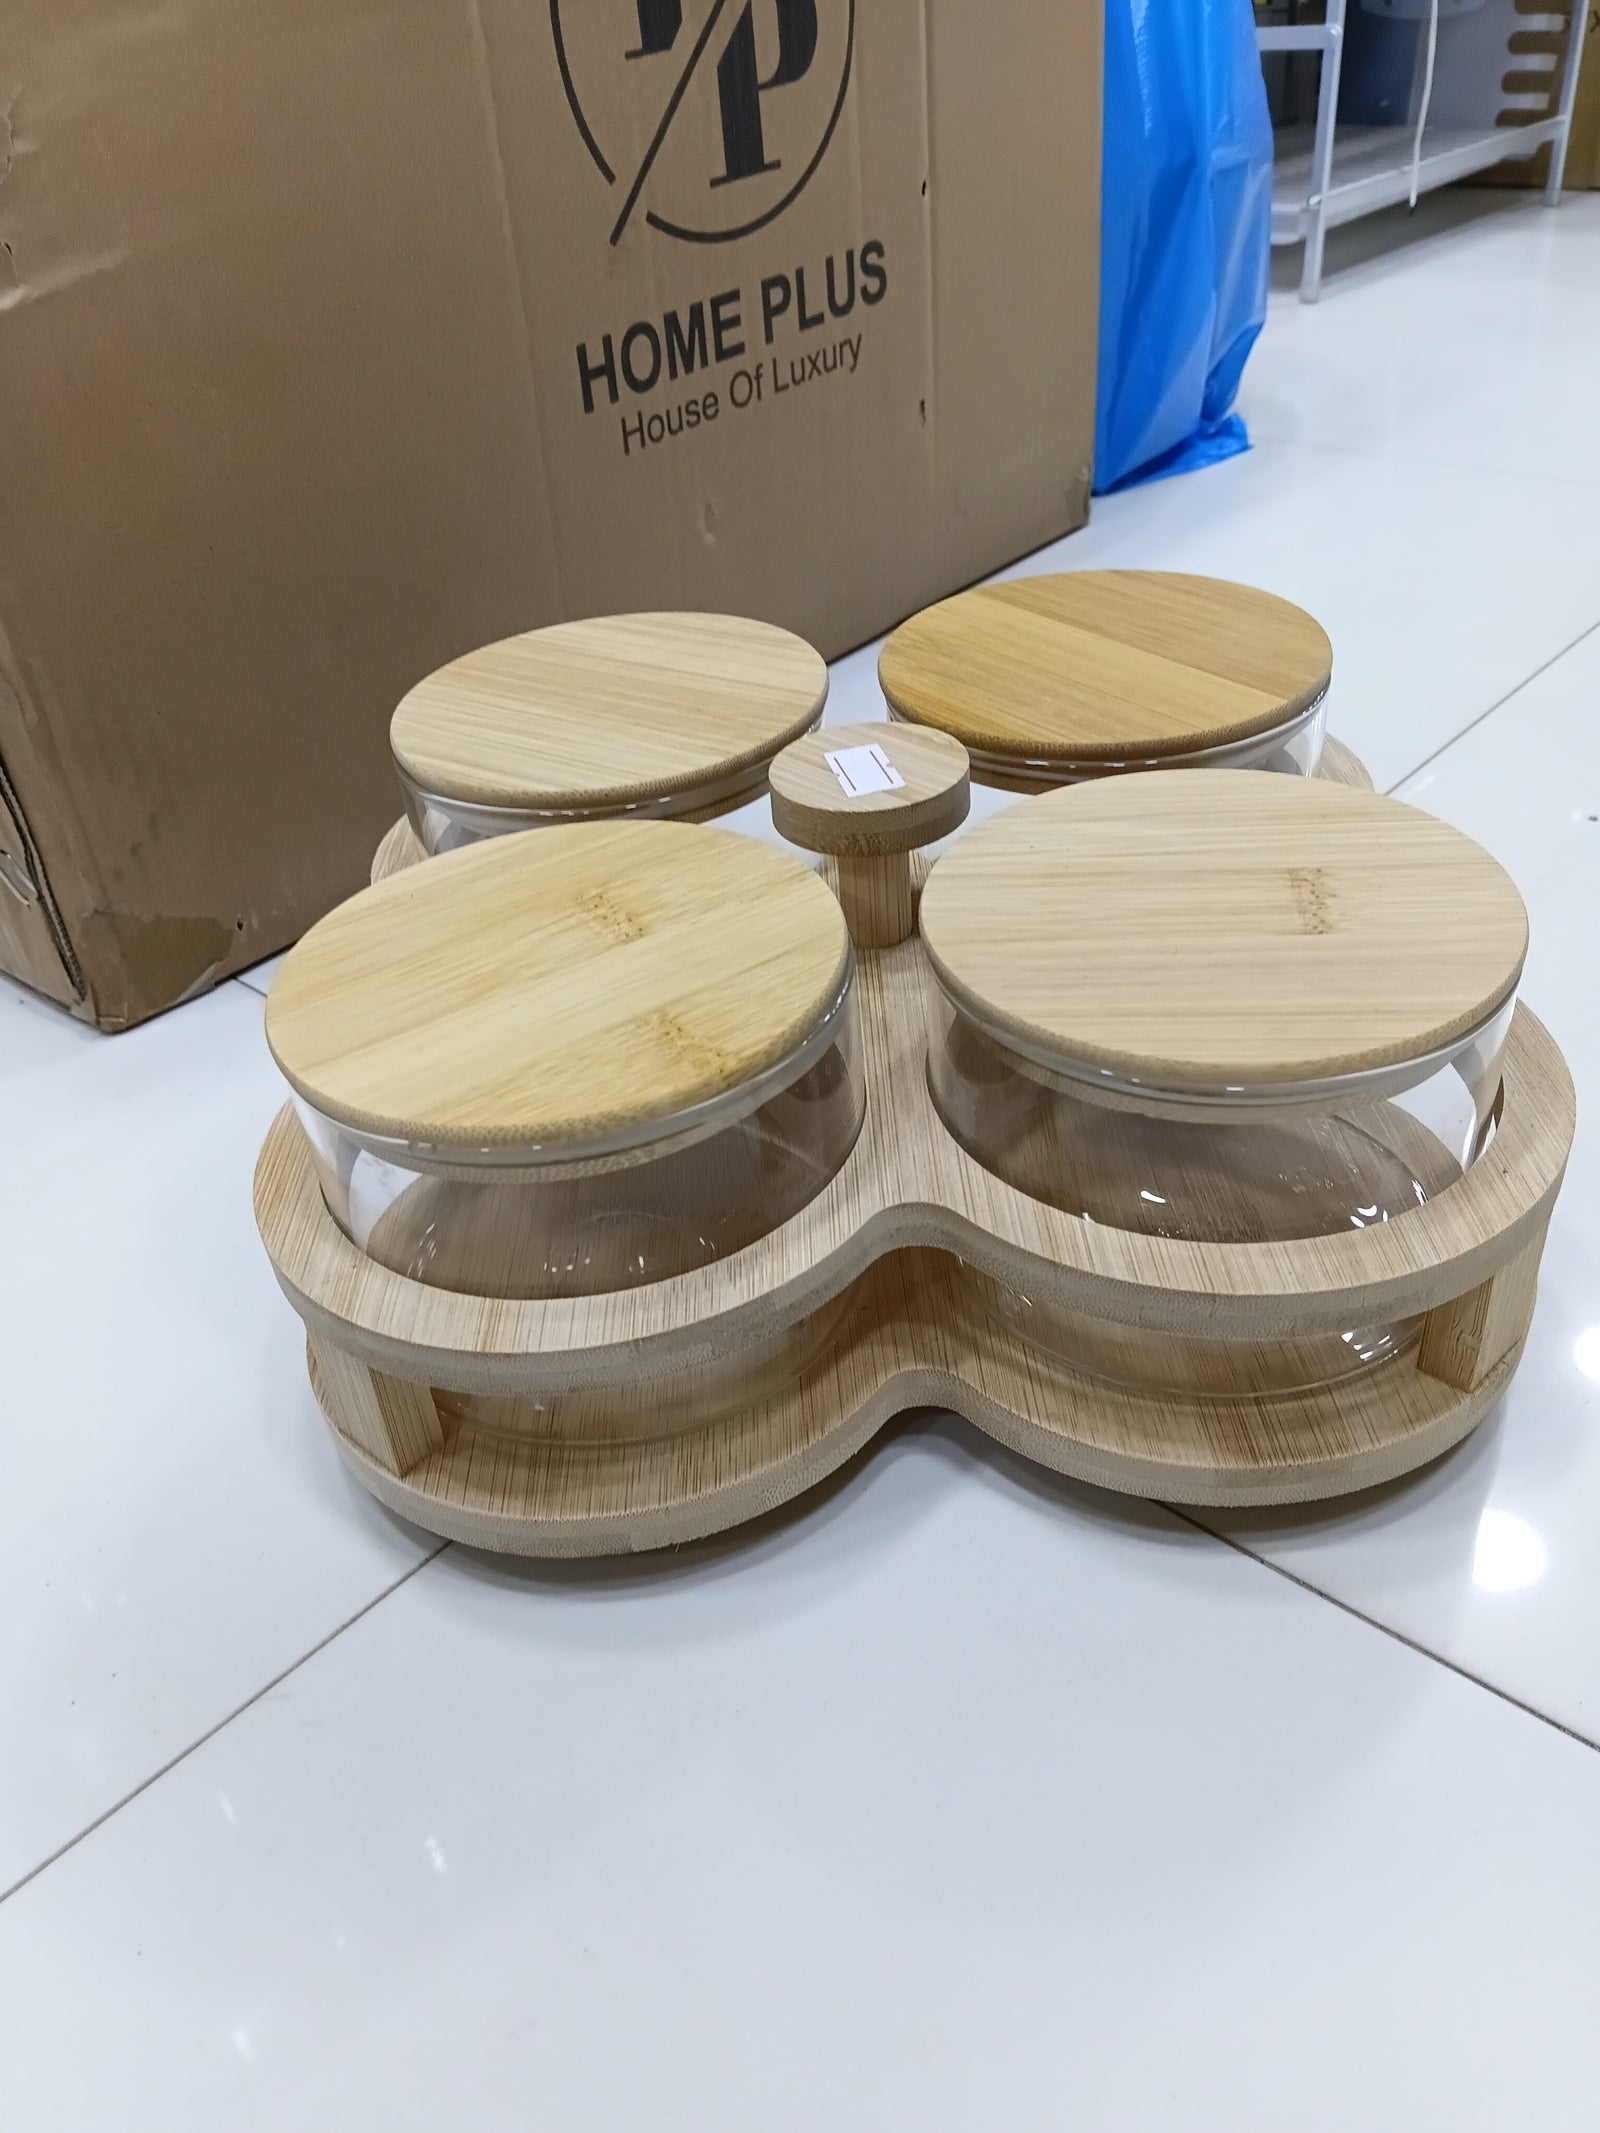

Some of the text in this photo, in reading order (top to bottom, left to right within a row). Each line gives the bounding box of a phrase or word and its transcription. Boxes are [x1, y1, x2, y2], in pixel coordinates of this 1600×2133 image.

[576, 240, 887, 414] HOME PLUS
[620, 333, 862, 456] House Of Luxury
